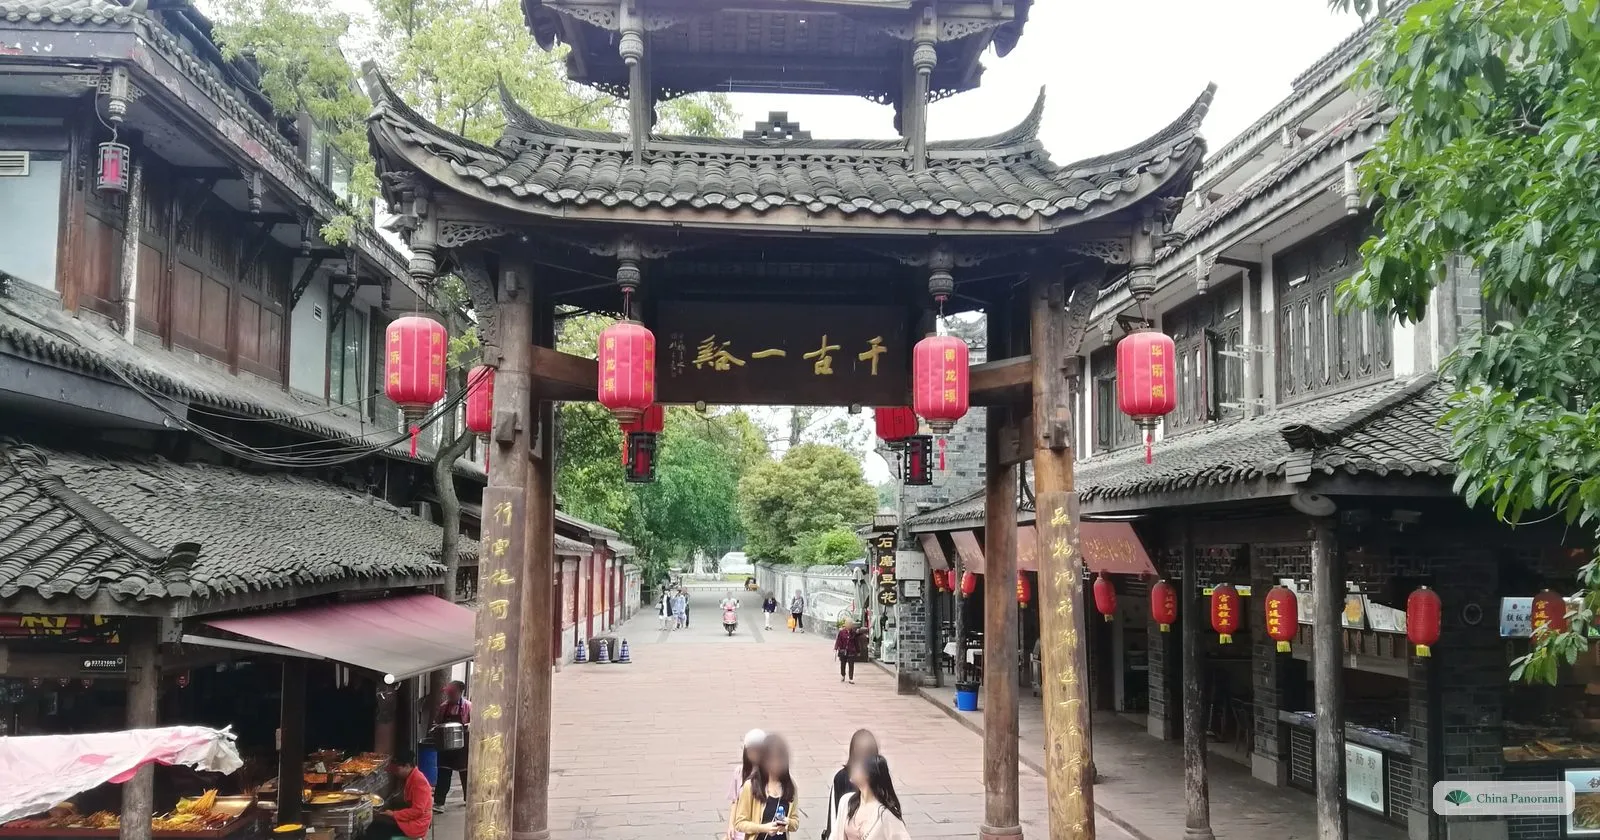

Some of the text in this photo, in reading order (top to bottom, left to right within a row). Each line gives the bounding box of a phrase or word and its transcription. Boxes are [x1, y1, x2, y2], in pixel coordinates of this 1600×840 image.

[605, 338, 616, 392] 黄龙溪
[944, 348, 957, 403] 黄龙溪
[877, 537, 897, 604] 石磨豆花
